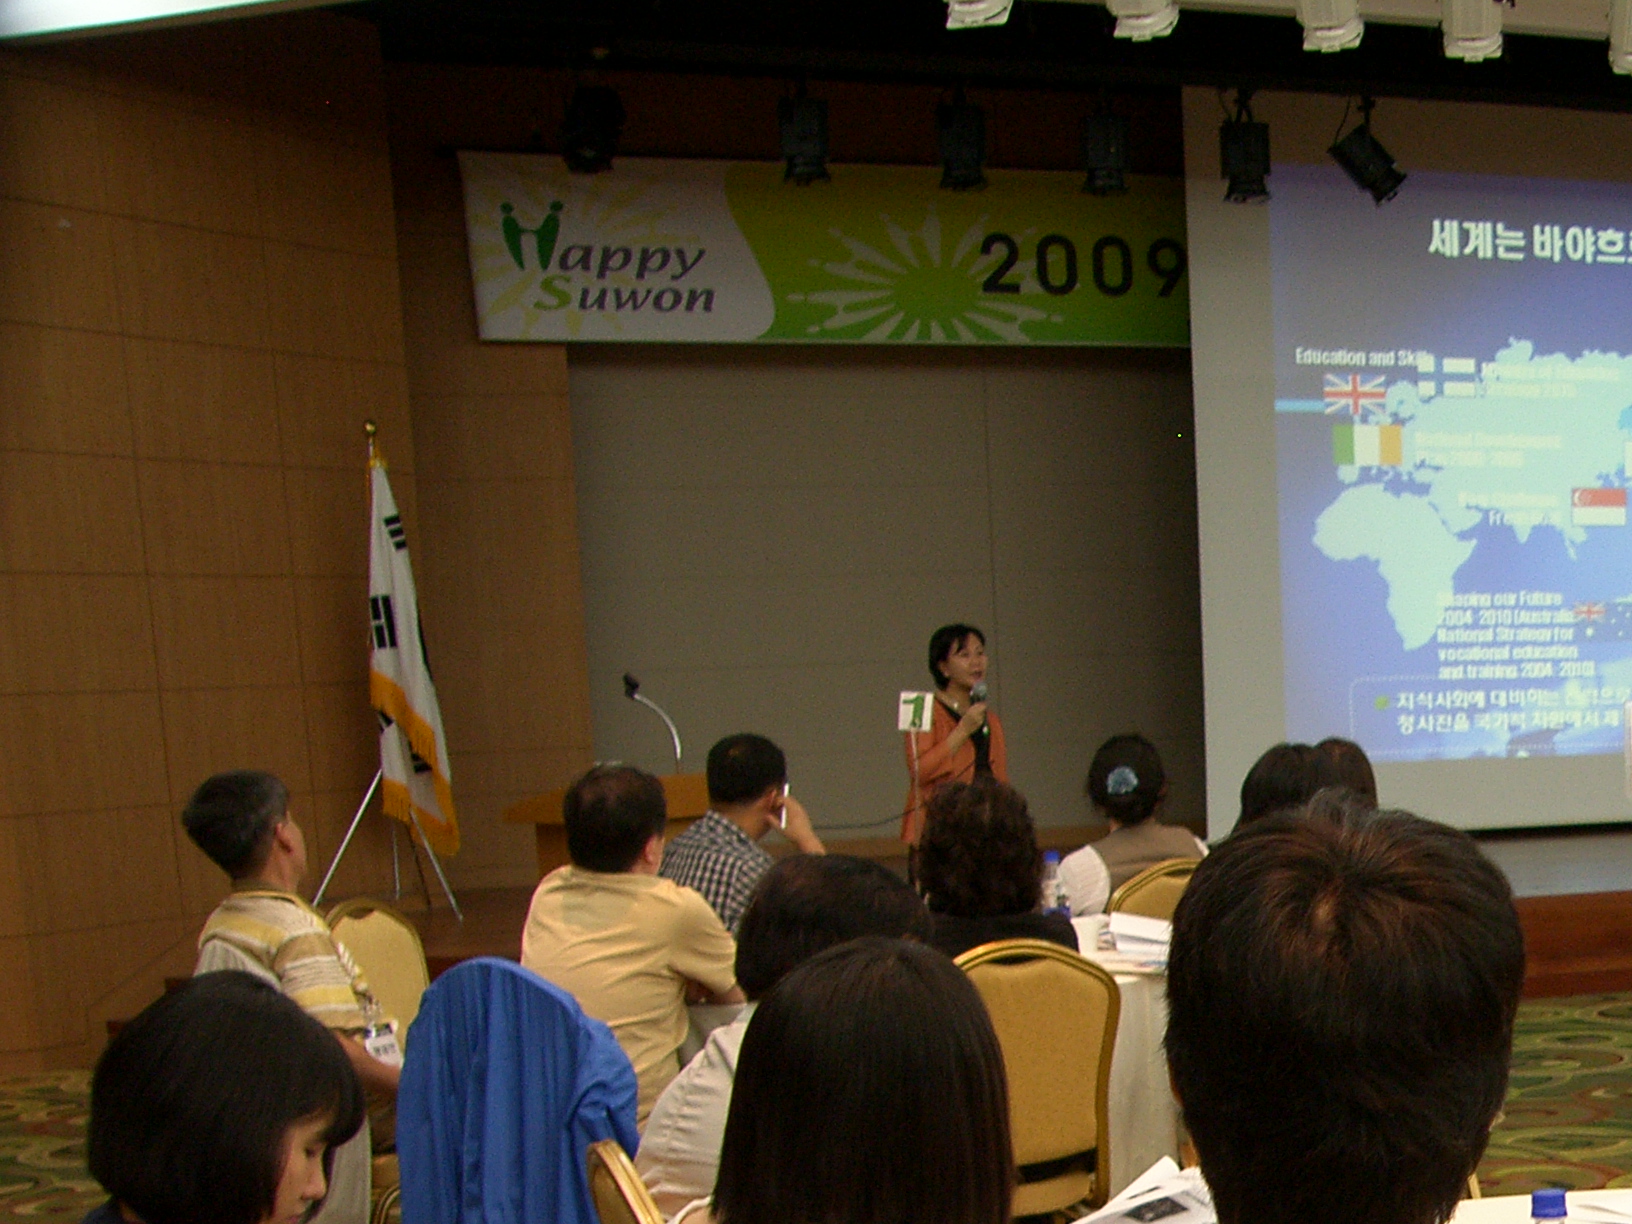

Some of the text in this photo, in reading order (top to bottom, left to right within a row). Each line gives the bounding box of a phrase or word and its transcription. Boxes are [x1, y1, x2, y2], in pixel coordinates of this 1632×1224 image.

[500, 201, 707, 281] Happy
[1427, 217, 1526, 261] 세계는
[979, 231, 1186, 299] 2009
[533, 275, 715, 315] Suwon
[1295, 346, 1366, 366] Education
[1368, 349, 1395, 367] and
[1494, 592, 1518, 607] our
[1519, 589, 1563, 606] Future
[1437, 627, 1494, 643] National
[1512, 644, 1579, 660] education
[1438, 664, 1464, 680] and
[1466, 663, 1518, 680] training
[902, 695, 925, 728] 1
